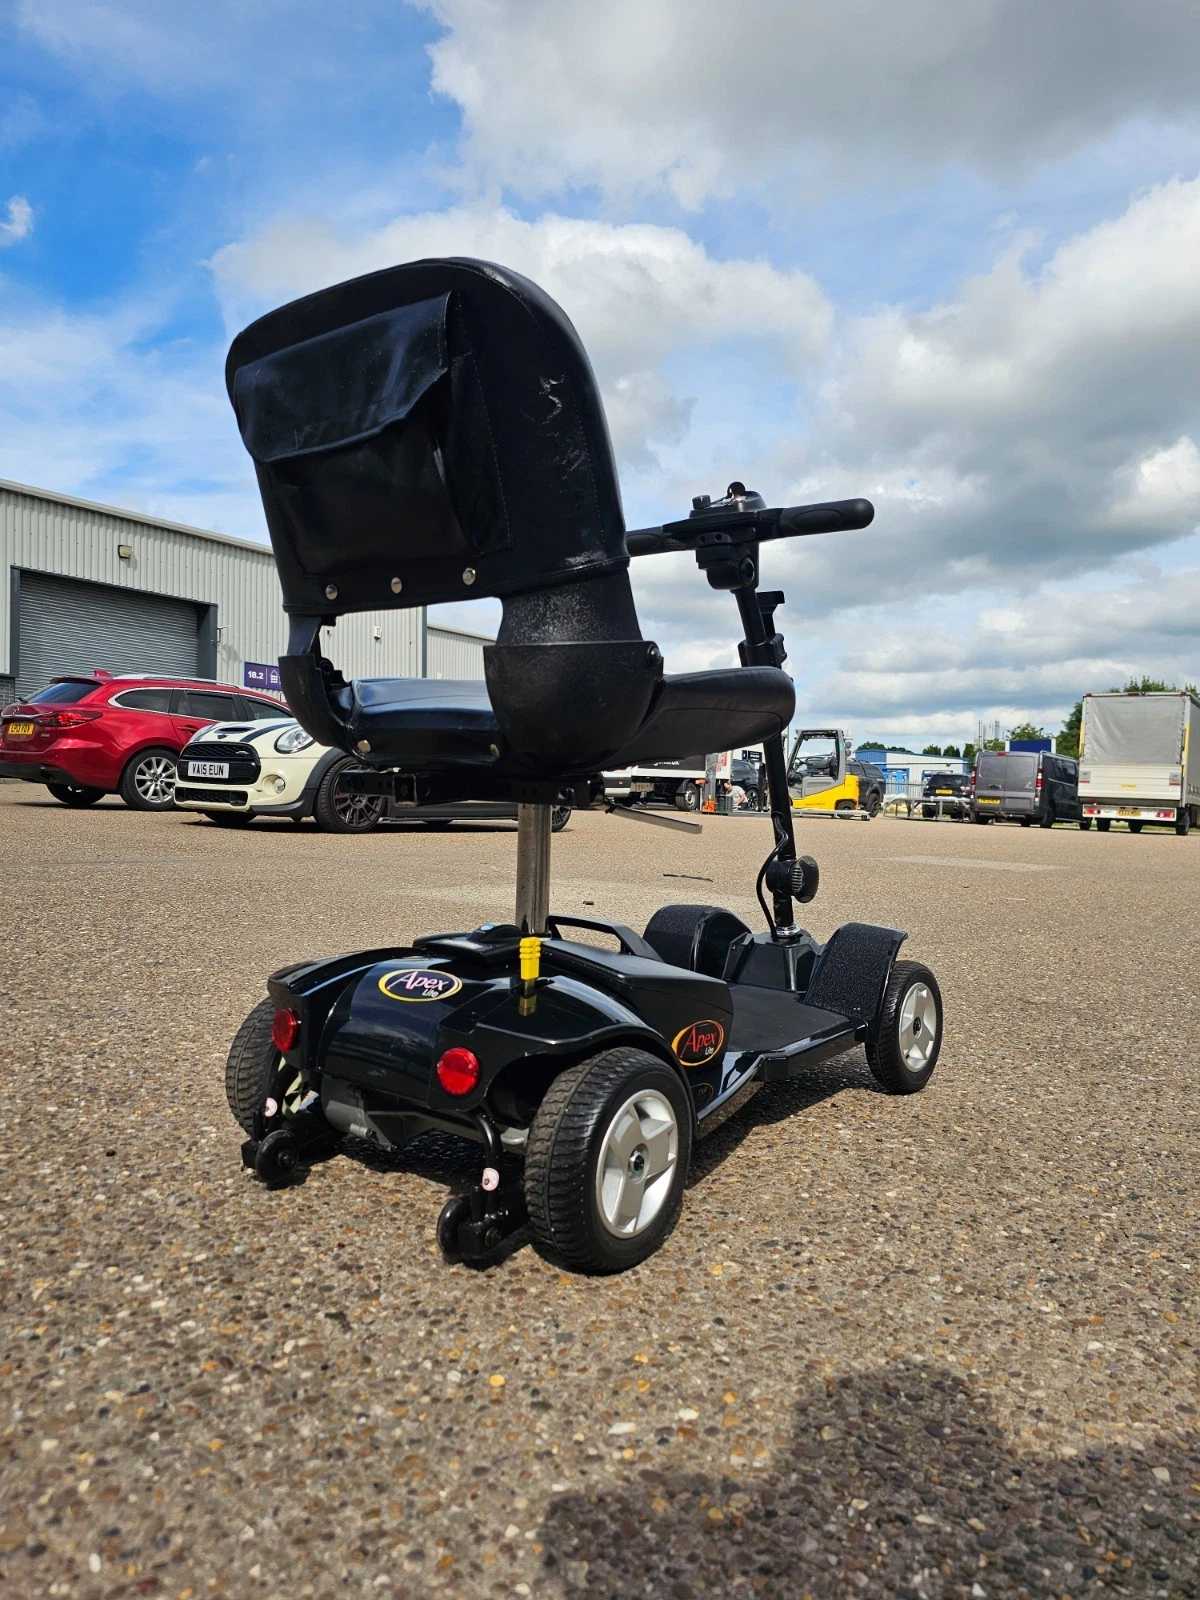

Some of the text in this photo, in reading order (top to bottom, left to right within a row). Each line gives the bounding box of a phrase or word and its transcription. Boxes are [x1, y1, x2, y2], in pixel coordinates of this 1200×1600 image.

[248, 671, 264, 680] 18.2
[192, 763, 224, 776] VA15 EUN
[386, 970, 449, 991] Apex
[421, 988, 439, 998] Lite
[680, 1026, 717, 1058] Apex
